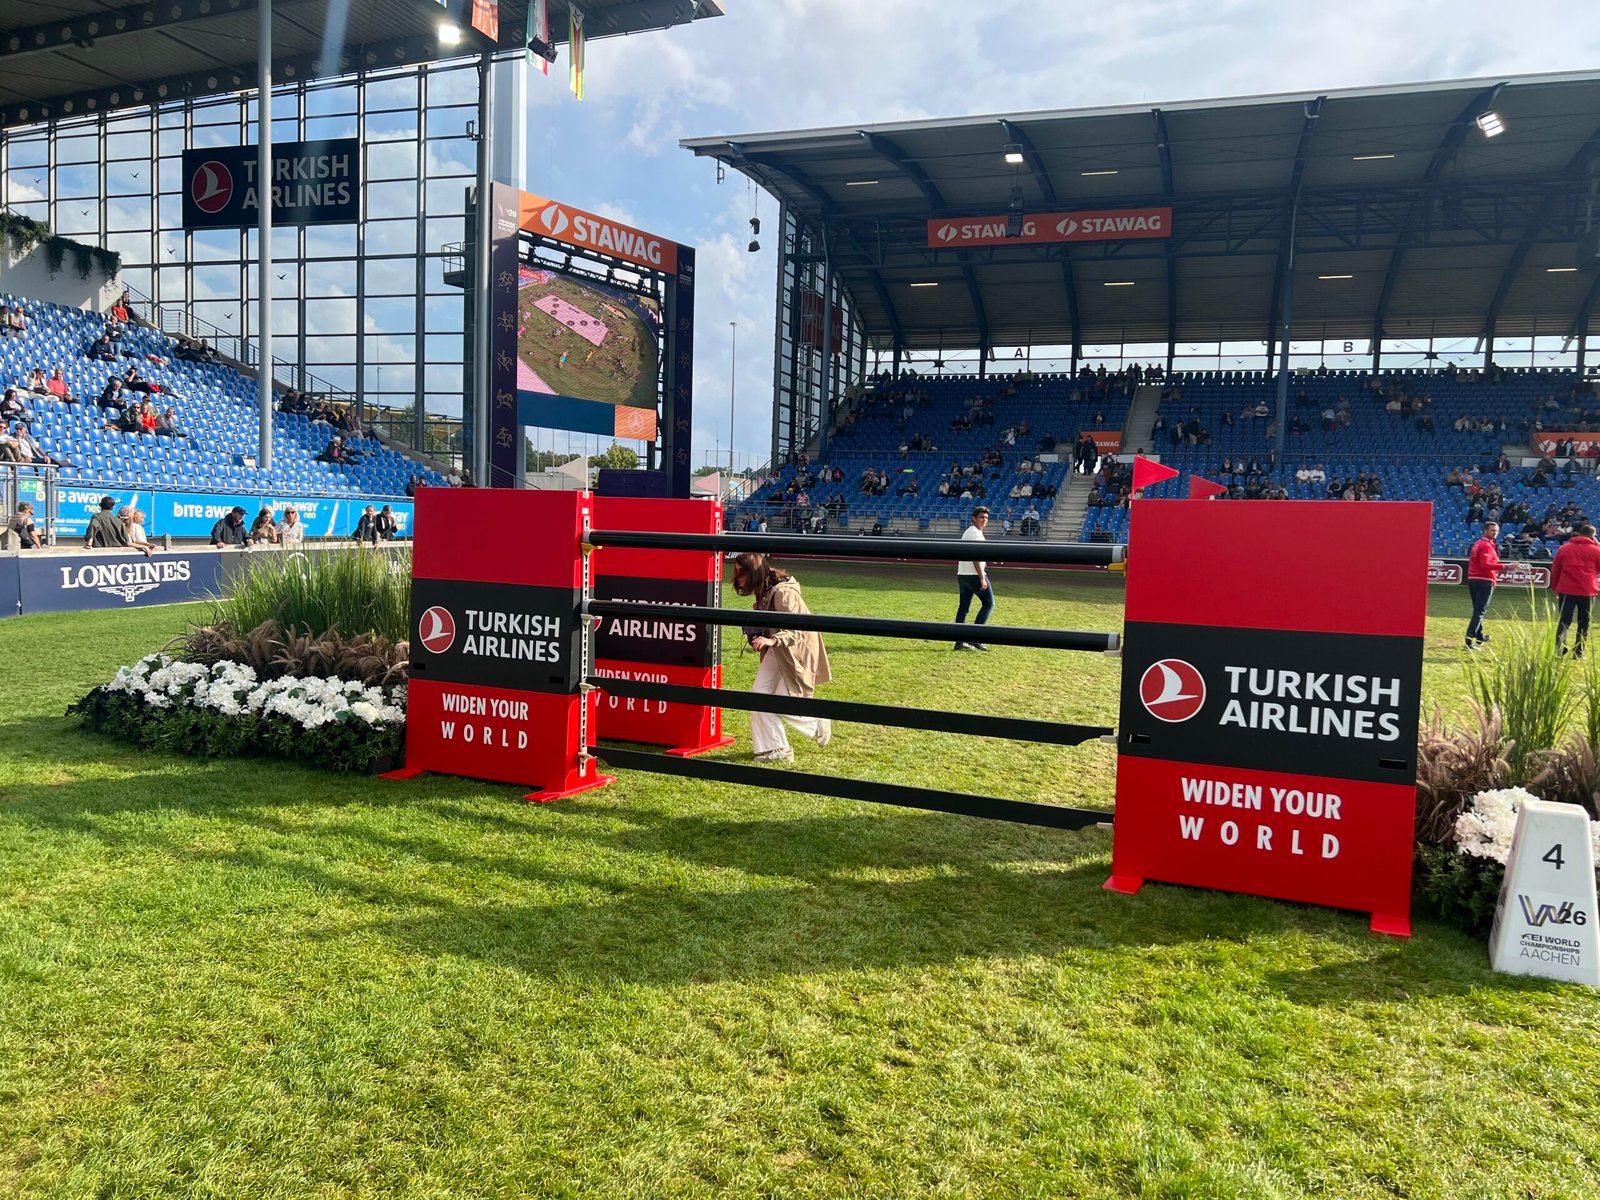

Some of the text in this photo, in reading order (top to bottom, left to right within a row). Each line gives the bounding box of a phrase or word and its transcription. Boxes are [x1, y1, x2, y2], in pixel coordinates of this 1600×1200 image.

[243, 154, 349, 183] TRKISH
[242, 181, 351, 209] ARLINES
[961, 221, 1037, 240] STAWG
[1081, 215, 1161, 233] STAWAG
[573, 215, 661, 265] STAWAG
[1014, 347, 1024, 358] A
[1343, 341, 1354, 353] B
[61, 560, 191, 589] LONGINES
[465, 610, 561, 638] TURKISH
[609, 618, 697, 642] AIRLINES
[462, 634, 560, 663] AIRLINES
[1224, 665, 1401, 707] TURKISH
[442, 693, 529, 721] WIDEN YOUR
[1218, 699, 1401, 742] AIRLINES
[441, 720, 528, 749] WORLD
[1181, 777, 1342, 820] WIDEN YOUR
[1179, 814, 1340, 859] WORLD
[1542, 843, 1566, 870] 4
[1520, 940, 1581, 955] CHAMPIONSHIPS
[1545, 935, 1581, 948] WORLD
[1519, 947, 1581, 967] AACHEN
